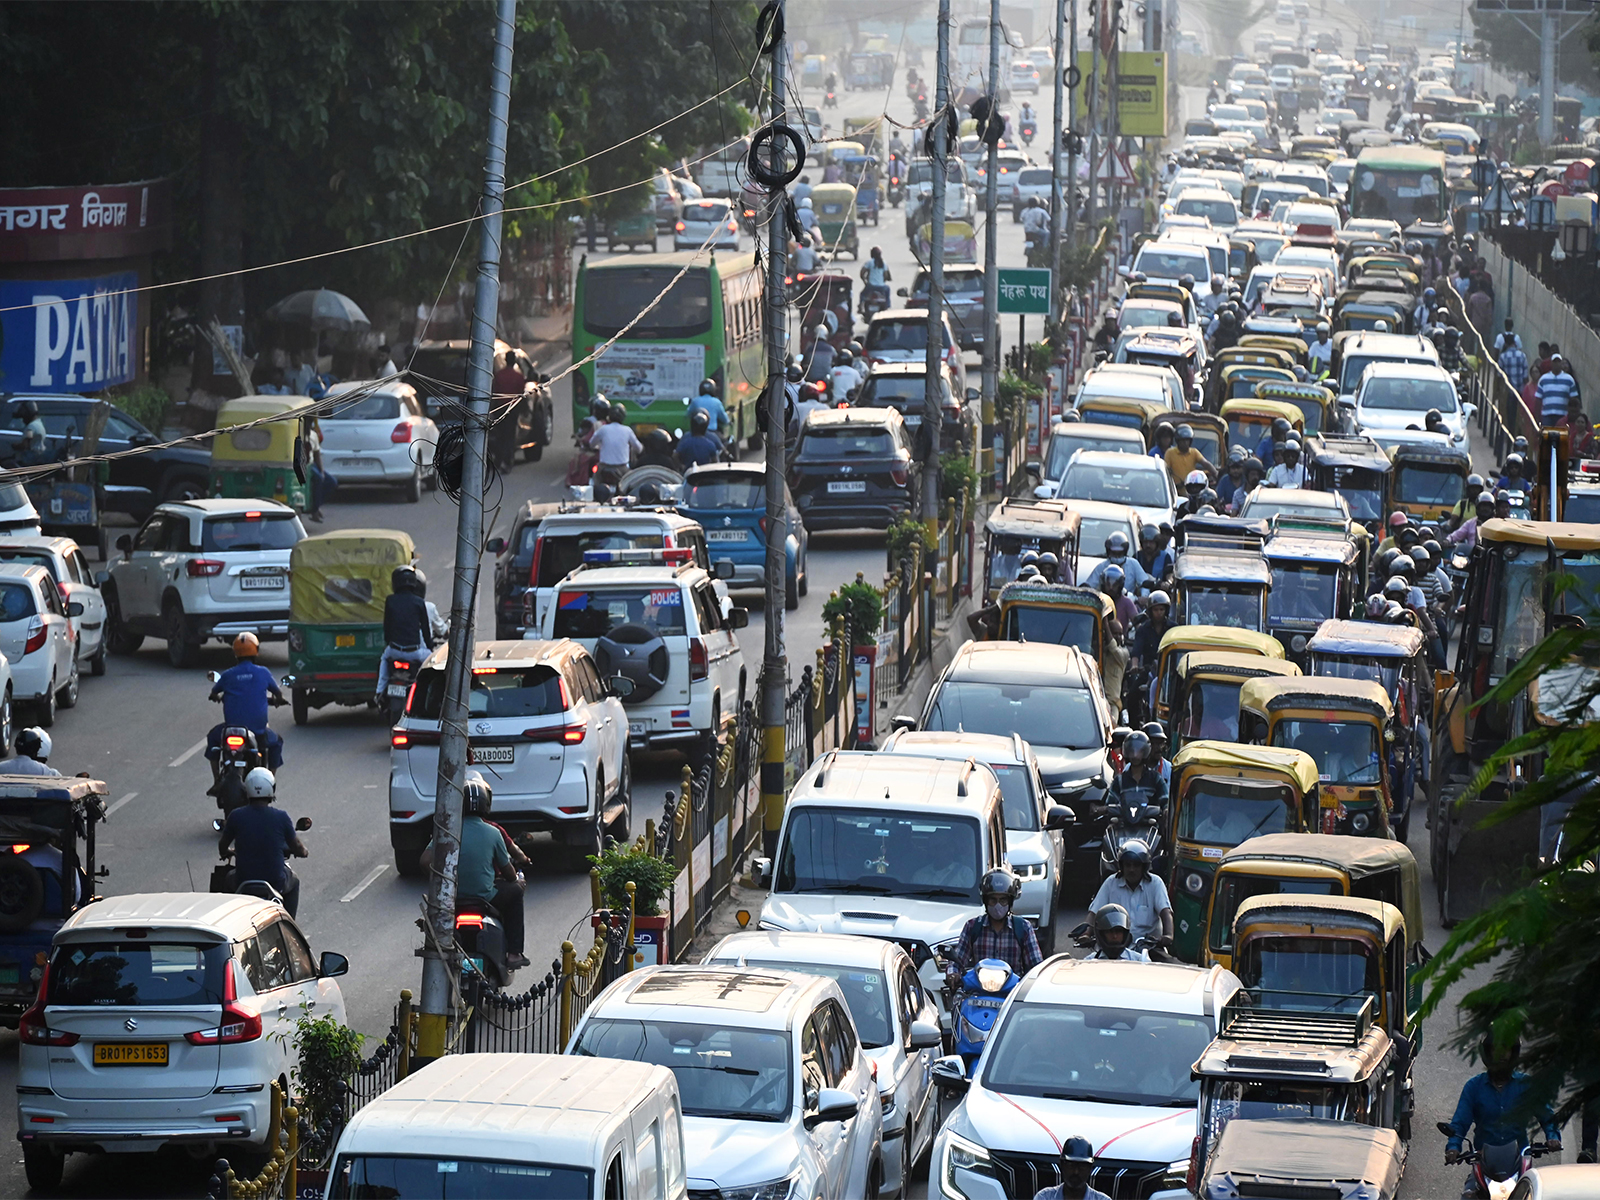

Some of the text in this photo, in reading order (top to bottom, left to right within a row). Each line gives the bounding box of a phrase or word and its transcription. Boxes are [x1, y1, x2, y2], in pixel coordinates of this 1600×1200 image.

[81, 192, 127, 227] निगम
[1000, 278, 1047, 300] नेहरू पथ
[30, 287, 128, 386] PATNA
[652, 592, 680, 605] POLICE
[101, 1047, 166, 1060] BR01PS1653
